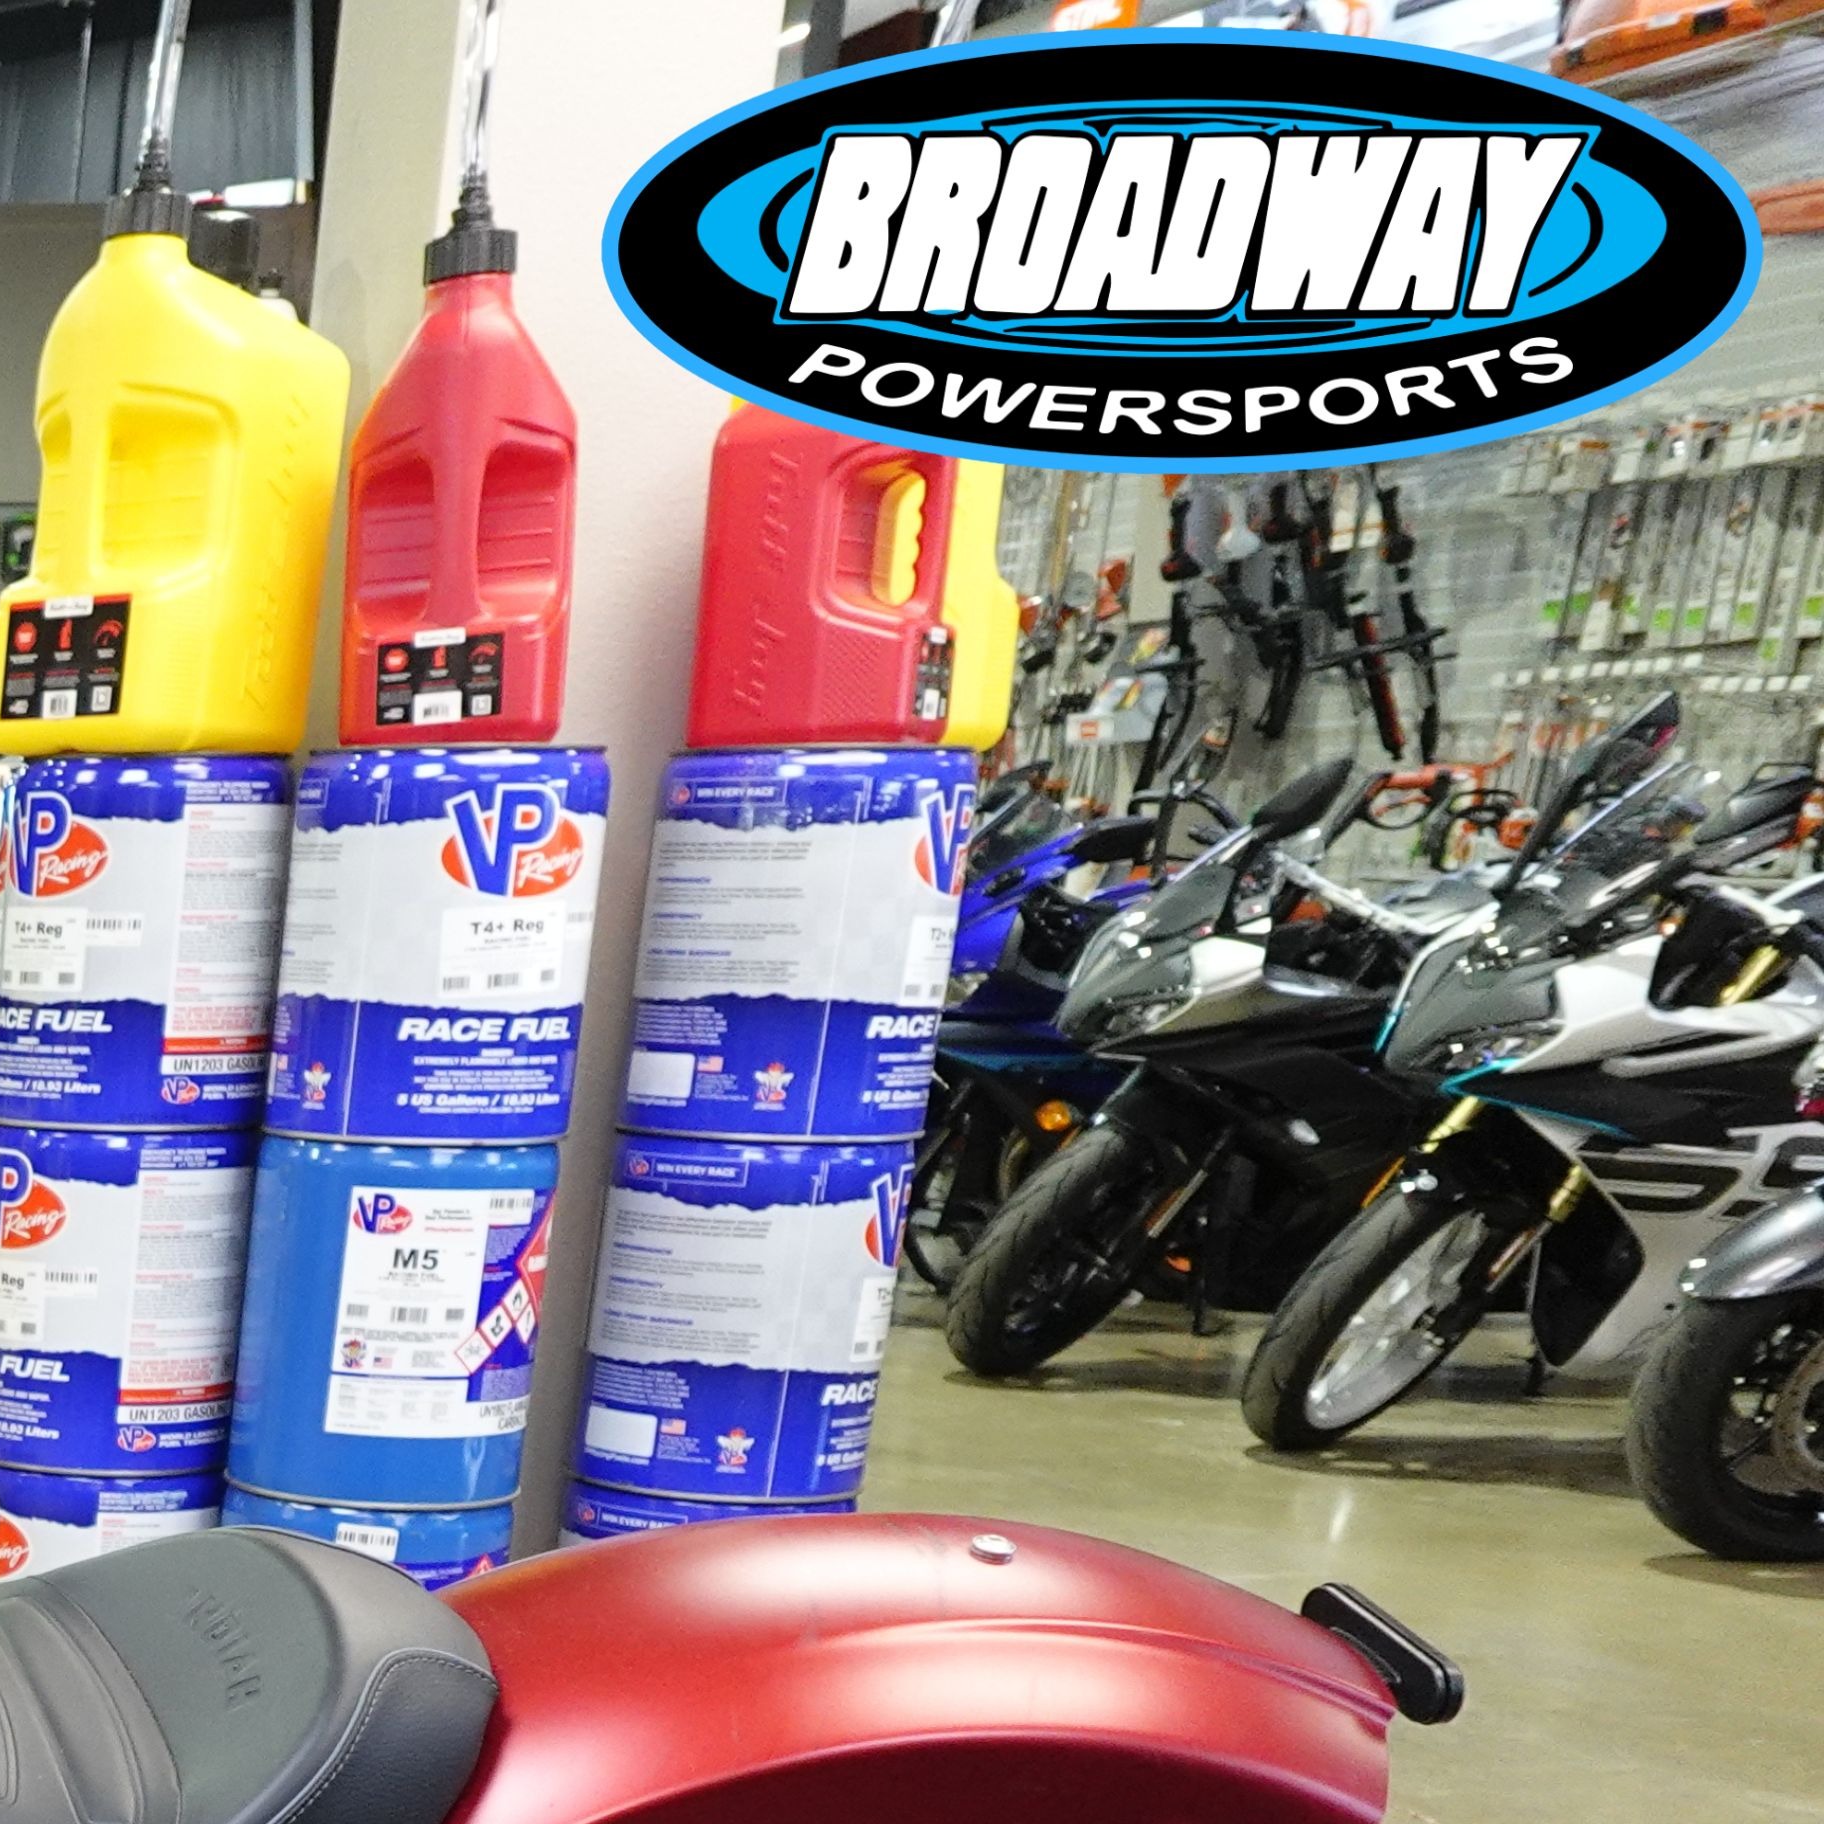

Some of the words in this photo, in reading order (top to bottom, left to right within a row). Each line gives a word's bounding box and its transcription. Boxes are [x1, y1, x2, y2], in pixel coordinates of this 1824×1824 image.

[715, 786, 745, 798] EVERY
[746, 786, 775, 798] RACE
[12, 791, 73, 897] VP
[446, 783, 560, 897] VP
[39, 847, 108, 888] Racing
[516, 846, 584, 889] Racing
[36, 920, 63, 938] Reg
[512, 918, 545, 934] Reg
[35, 1009, 113, 1033] FUEL
[397, 1017, 506, 1042] RACE
[507, 1016, 571, 1042] FUEL
[866, 1015, 935, 1040] RACE
[173, 1057, 224, 1073] UN1203
[63, 1081, 102, 1095] Liters
[410, 1093, 433, 1106] US
[435, 1093, 489, 1107] Gallons
[675, 1164, 707, 1176] EVERY
[708, 1166, 736, 1178] RACE
[357, 1193, 397, 1234] VP
[3, 1206, 66, 1242] Racing
[392, 1248, 440, 1271] M5
[1, 1271, 26, 1289] Reg
[0, 1356, 71, 1383] FUEL
[129, 1404, 181, 1422] UN1203
[25, 1425, 60, 1440] Liters
[619, 1515, 649, 1528] EVERY
